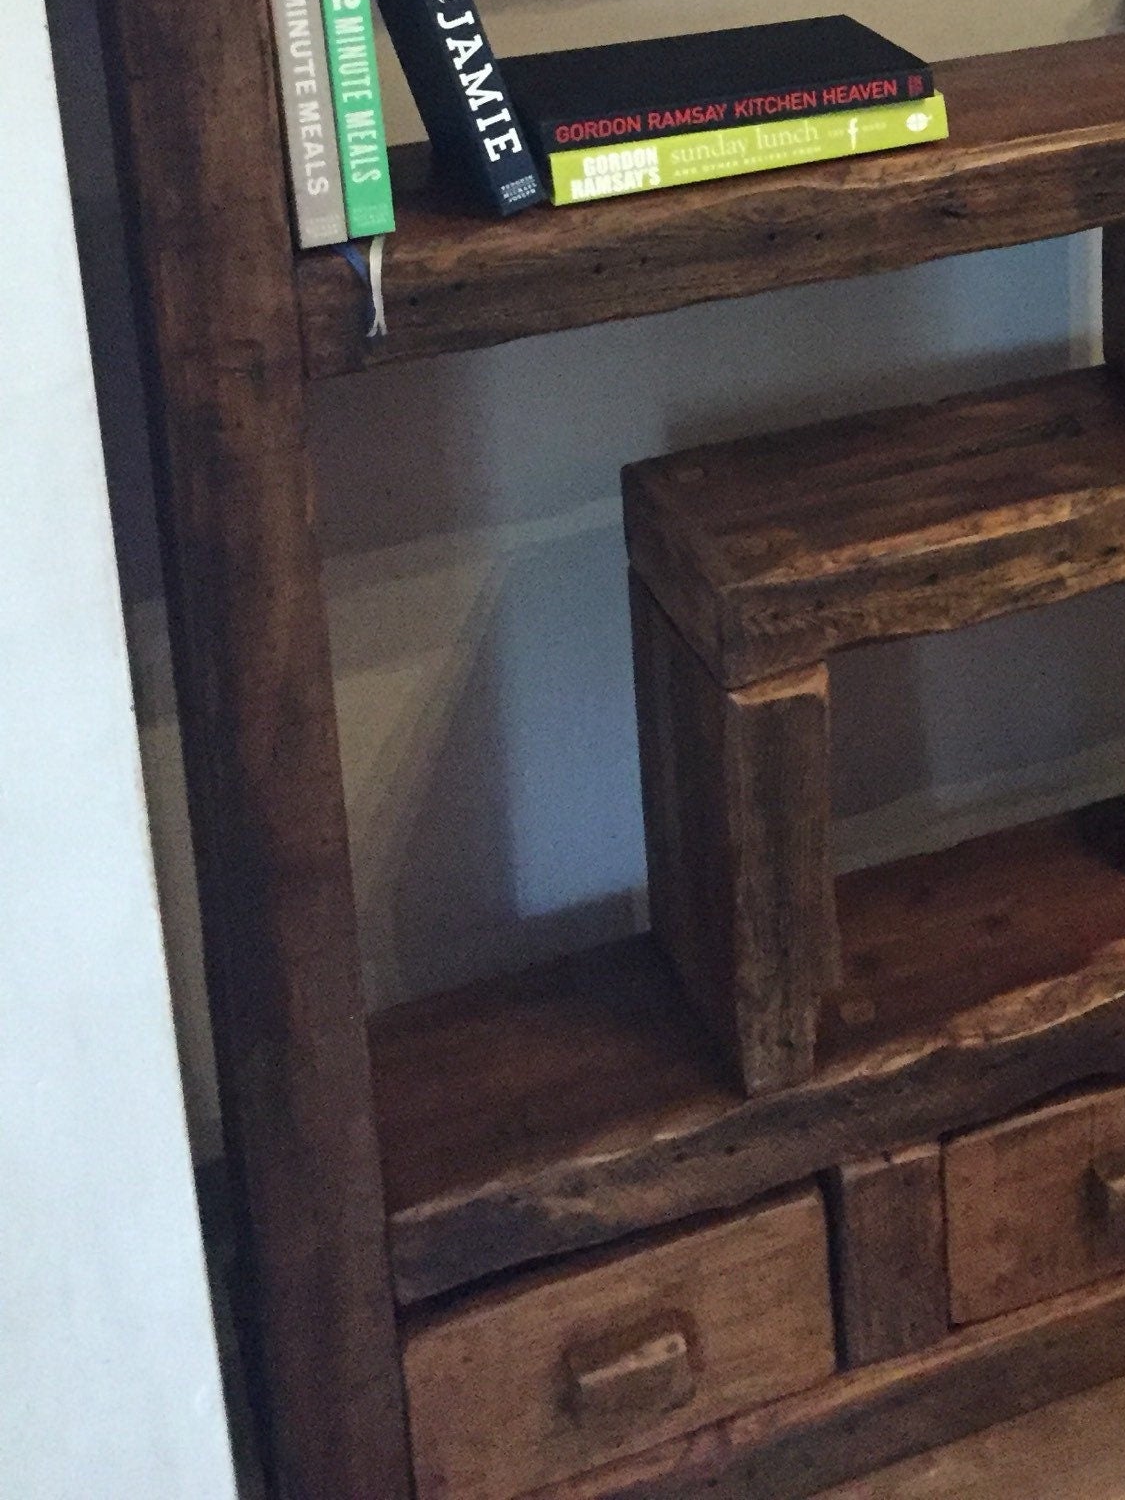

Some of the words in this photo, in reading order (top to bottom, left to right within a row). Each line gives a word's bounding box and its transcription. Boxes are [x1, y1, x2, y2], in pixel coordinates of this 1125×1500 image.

[334, 16, 373, 102] MINUTE
[437, 11, 523, 163] JAMIE
[556, 115, 642, 144] GORDON
[648, 103, 726, 130] RAMSAY
[734, 91, 817, 119] KITCHEN
[822, 79, 898, 106] HEAVEN
[670, 134, 748, 165] sunday
[755, 120, 820, 150] lunch
[296, 101, 329, 198] MEALS
[345, 109, 383, 185] MEALS
[582, 146, 658, 177] GORDON
[570, 167, 661, 200] RAMSAY'S
